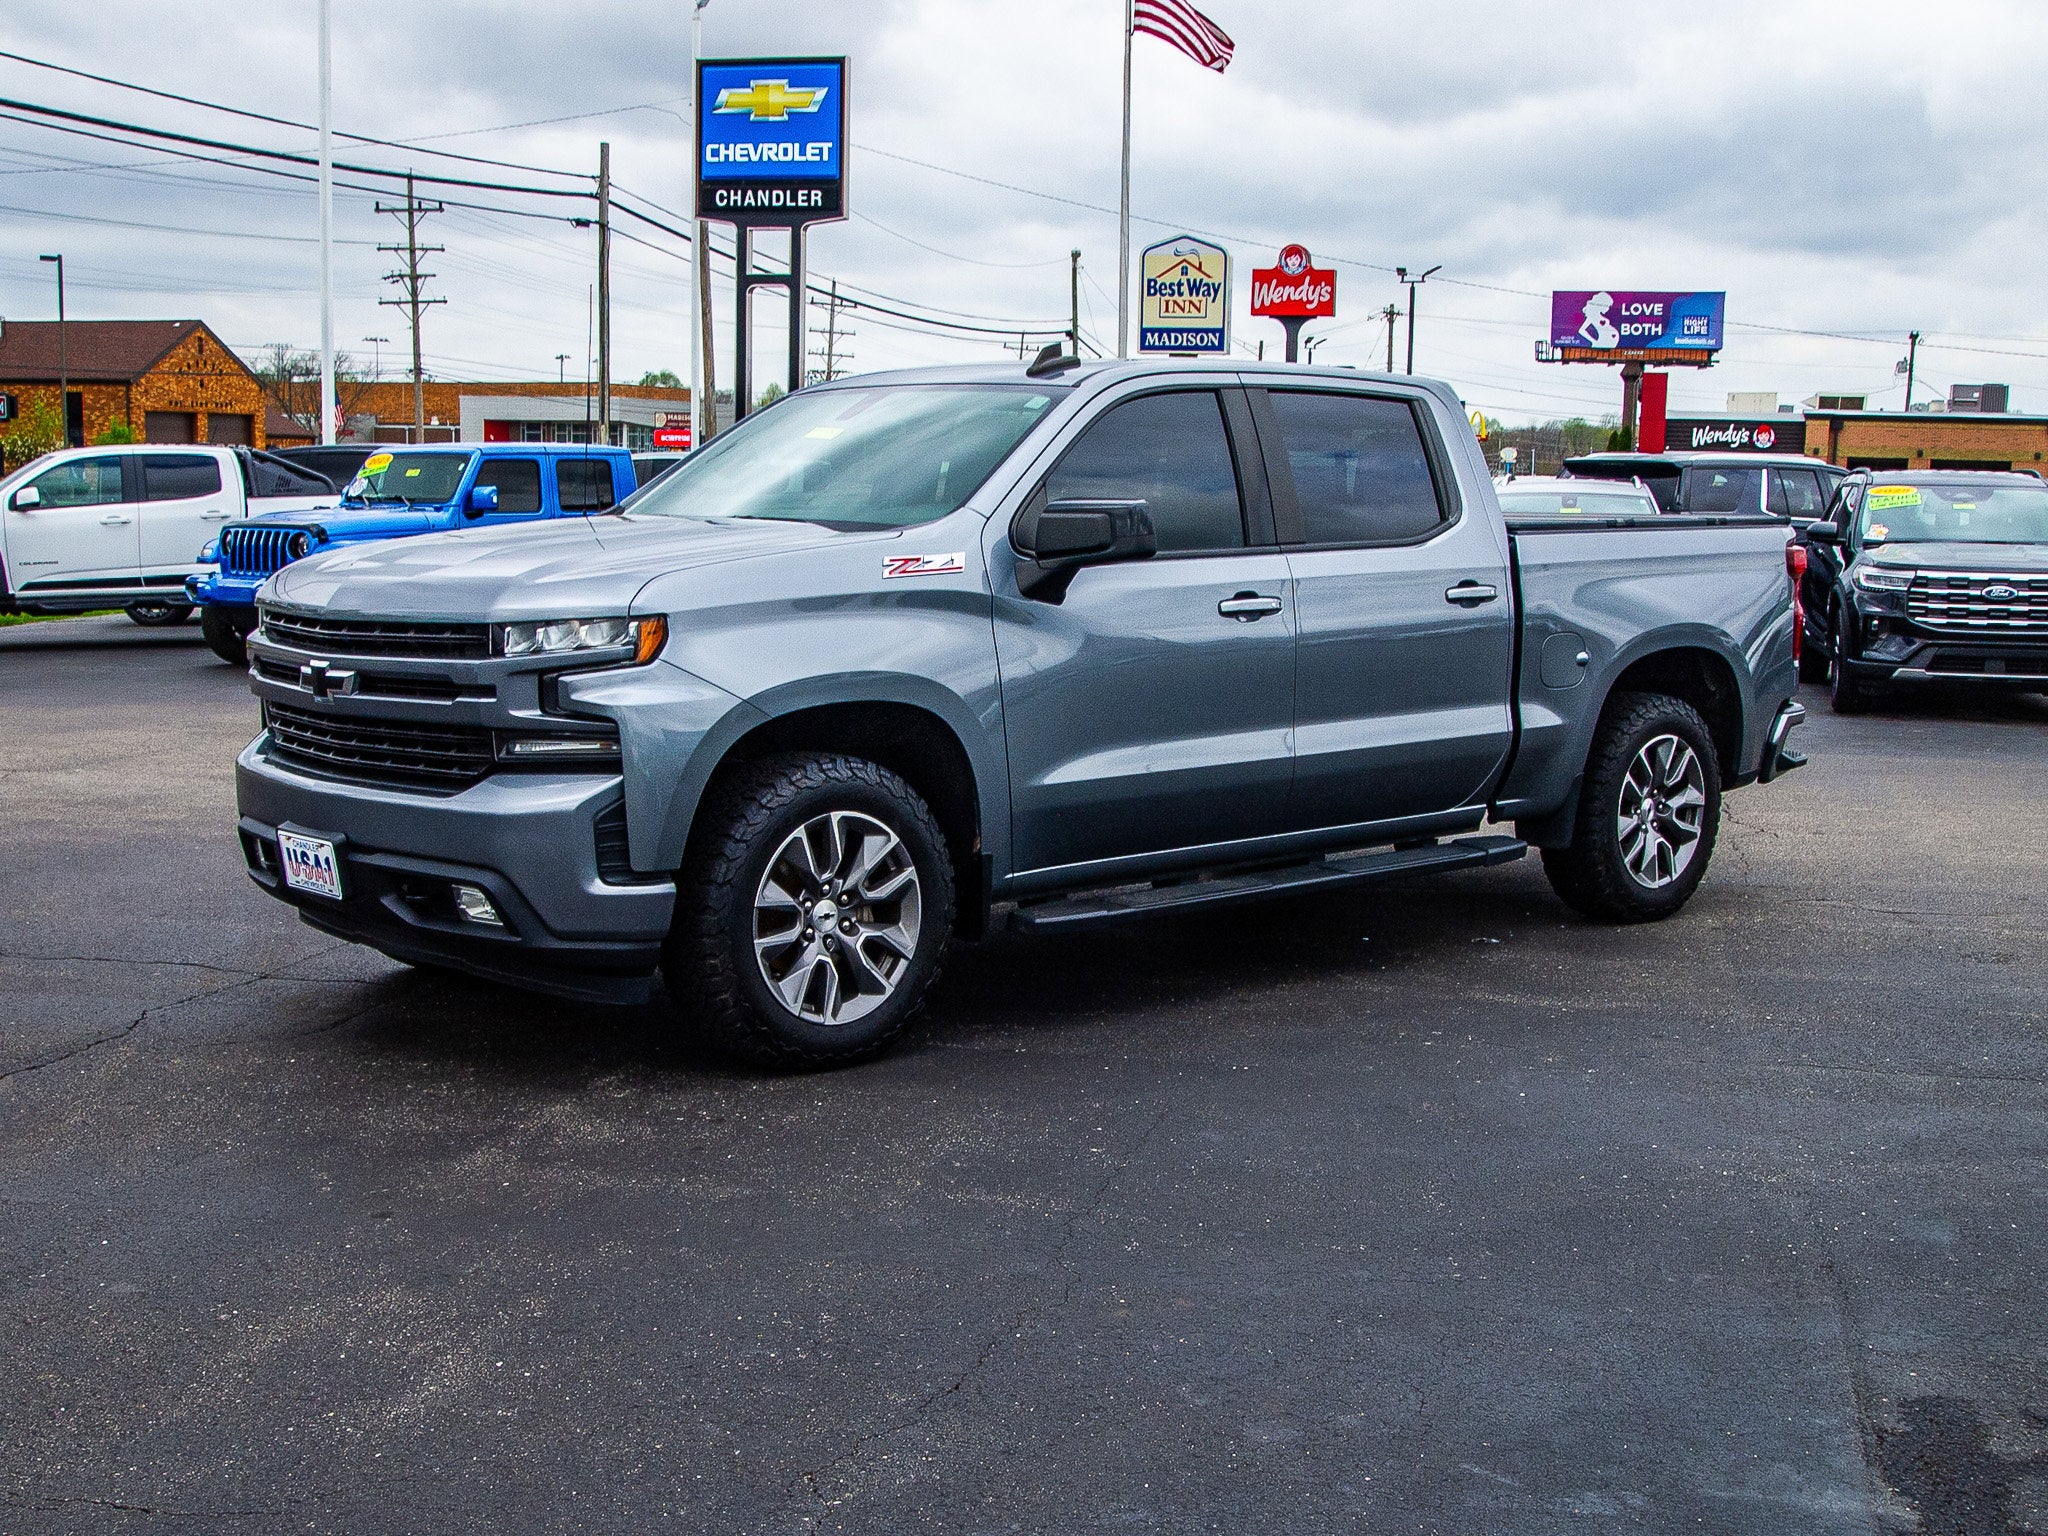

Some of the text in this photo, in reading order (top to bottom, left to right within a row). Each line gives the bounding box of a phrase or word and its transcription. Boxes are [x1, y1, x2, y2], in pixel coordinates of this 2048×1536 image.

[706, 142, 832, 162] CHEVROLET
[715, 190, 822, 206] CHANDLER
[1147, 278, 1221, 303] Best Way
[1254, 276, 1331, 309] Wendy's
[1163, 299, 1202, 314] INN
[1622, 303, 1663, 315] LOVE
[1621, 323, 1662, 336] BOTH
[1145, 332, 1220, 346] MADISON
[1692, 424, 1750, 448] Wendy's
